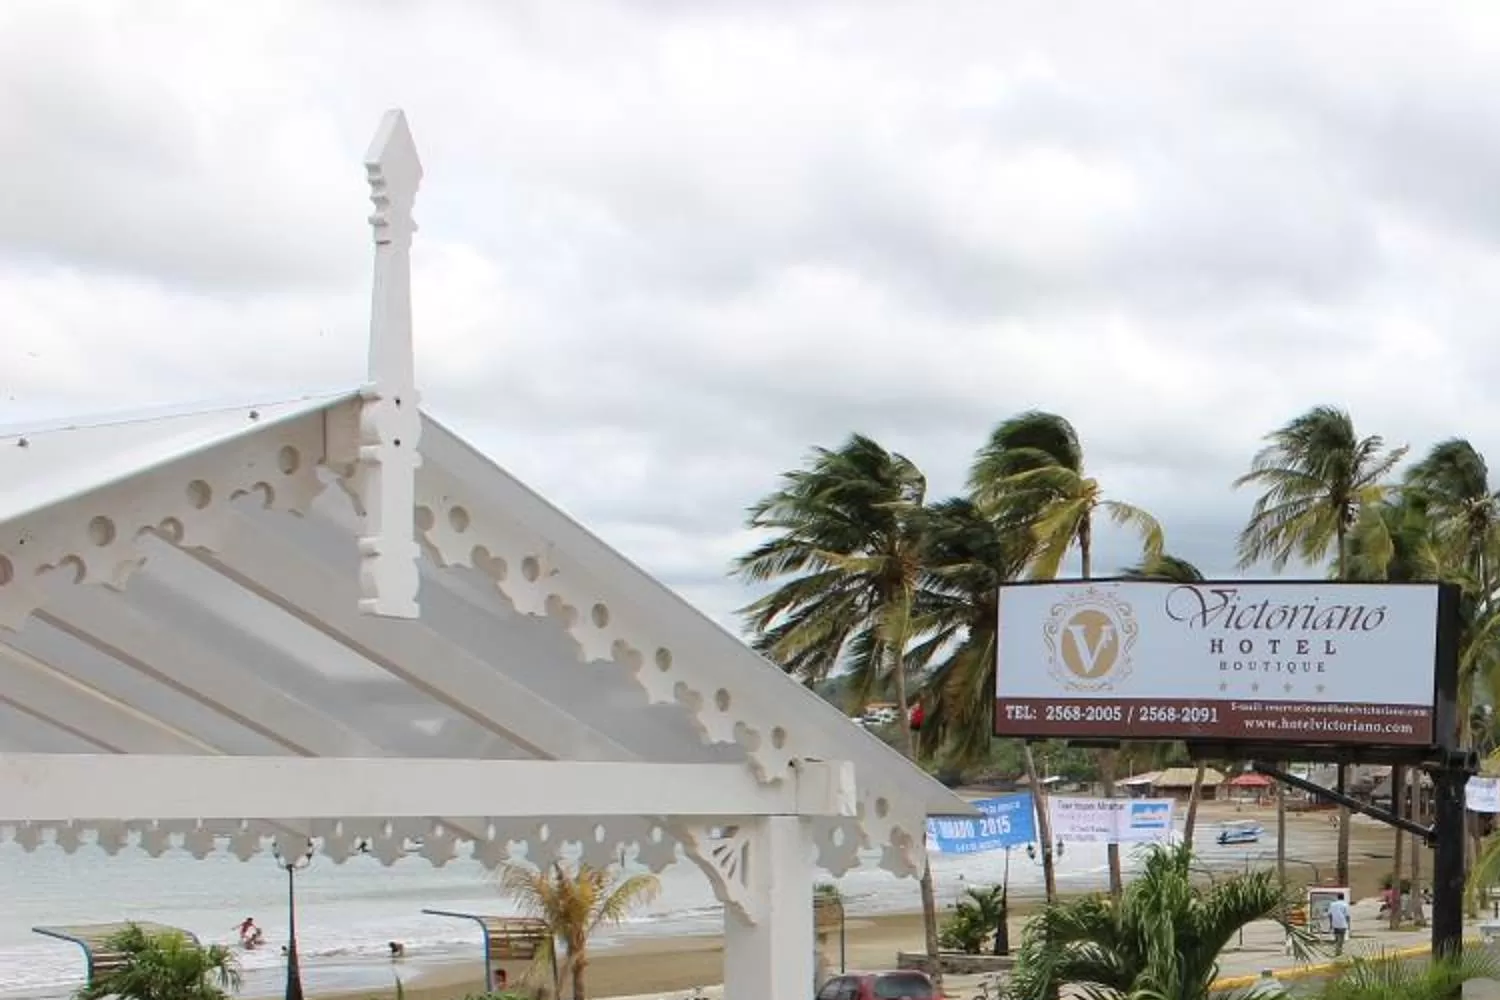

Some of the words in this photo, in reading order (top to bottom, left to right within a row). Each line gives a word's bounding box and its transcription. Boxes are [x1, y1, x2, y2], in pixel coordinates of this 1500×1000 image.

[1165, 585, 1387, 631] Victoriano
[1068, 624, 1113, 674] V
[1210, 638, 1337, 655] HOTEL
[1219, 660, 1326, 674] BOUTIQUE
[1005, 705, 1037, 720] TEL:
[1045, 706, 1122, 722] 2568-2005
[1139, 707, 1219, 723] 2568-2091
[1243, 717, 1413, 734] www.hotelvictoriano.com
[980, 815, 1011, 837] 2015
